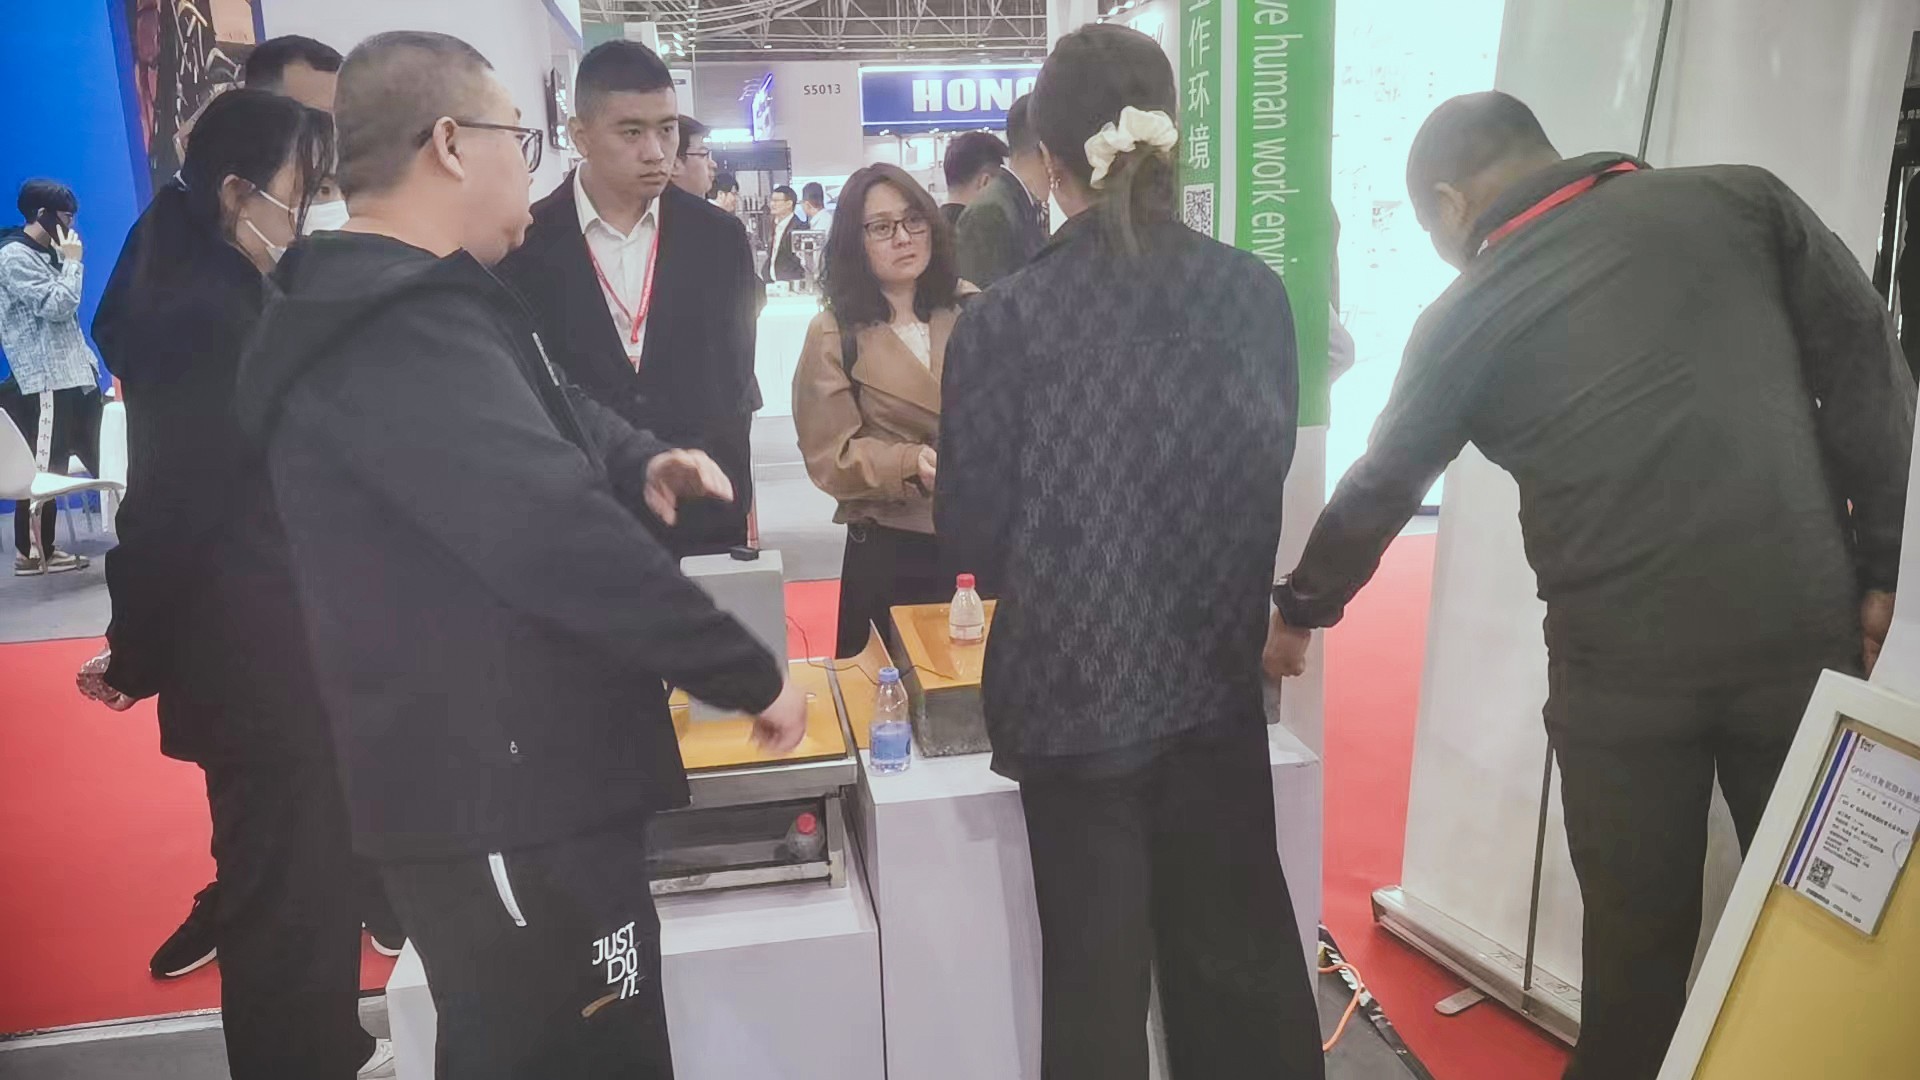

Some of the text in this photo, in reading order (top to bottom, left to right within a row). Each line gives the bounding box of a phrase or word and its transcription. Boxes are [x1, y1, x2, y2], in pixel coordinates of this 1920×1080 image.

[803, 83, 841, 95] S5013
[1188, 0, 1211, 169] 作环境
[1252, 34, 1303, 130] human
[1251, 137, 1300, 205] work
[592, 921, 635, 965] JUST
[607, 947, 637, 984] DO
[620, 971, 639, 1000] IT.
